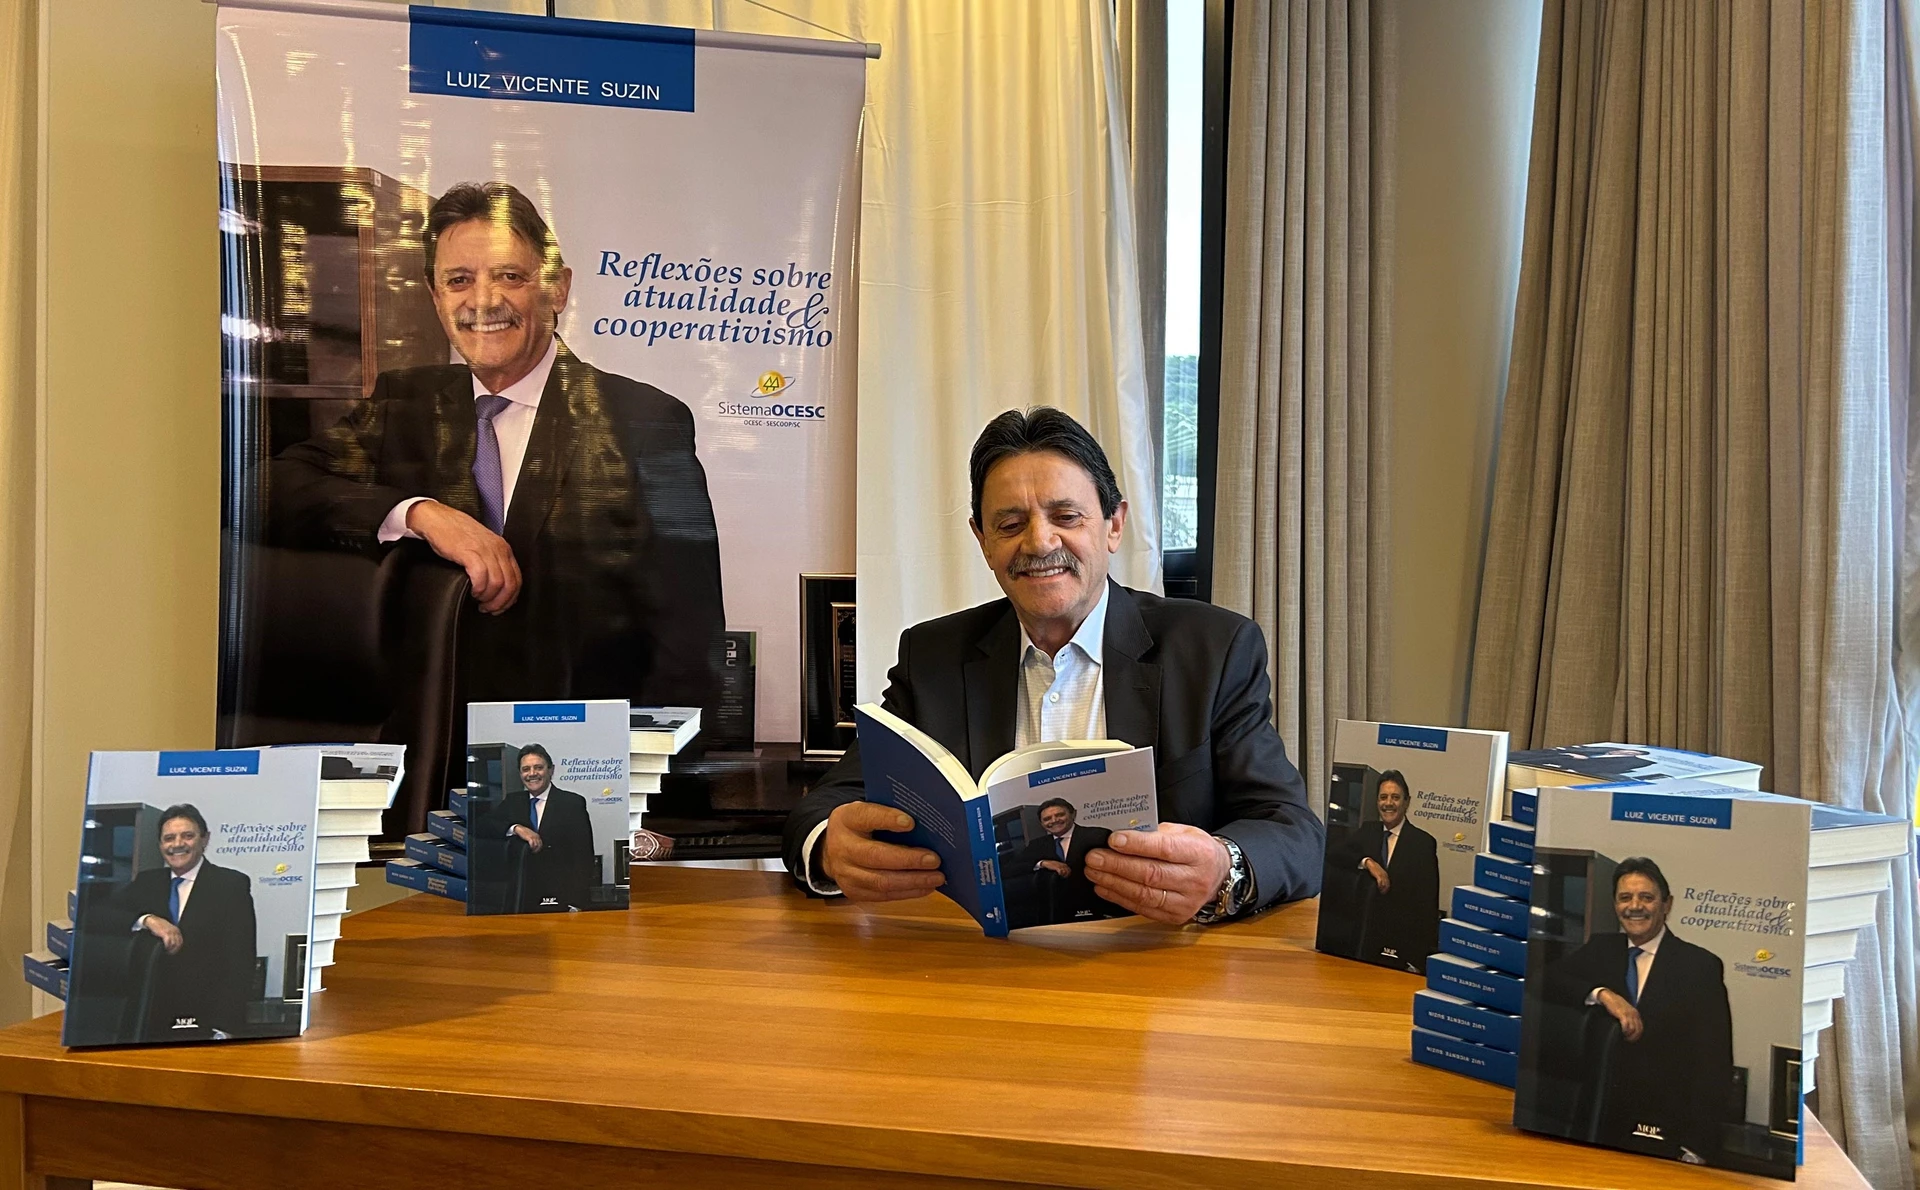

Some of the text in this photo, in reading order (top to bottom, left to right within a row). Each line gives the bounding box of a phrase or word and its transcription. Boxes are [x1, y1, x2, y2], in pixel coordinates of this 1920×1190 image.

[446, 71, 660, 100] LUIZ VICENTE SUZIN
[596, 250, 832, 290] Reflexões sobre
[623, 285, 830, 329] atualidade &
[593, 316, 833, 348] cooperativismo
[1399, 739, 1421, 747] VICENTE
[561, 757, 623, 767] Reflexões sobre
[189, 766, 222, 774] VICENTE
[567, 765, 611, 773] atualidade
[560, 773, 623, 783] cooperativismo
[1052, 772, 1077, 781] VICENTE
[1083, 798, 1124, 810] Reflexões
[1416, 790, 1480, 807] Reflexões sobre
[1090, 801, 1137, 813] atualidade
[1422, 801, 1466, 814] atualidade
[1414, 809, 1477, 825] cooperativismo
[1624, 811, 1717, 825] LUIZ VICENTE SUZIN
[220, 822, 307, 835] Reflexões sobre
[227, 832, 290, 844] atualidade
[216, 843, 305, 856] cooperativismo
[1684, 887, 1795, 910] Reflexões sobre
[1694, 903, 1773, 921] atualidade
[1680, 916, 1794, 936] cooperativismo
[1441, 974, 1457, 982] SUZIN
[1459, 979, 1481, 989] VICENTE
[1428, 1011, 1486, 1031] LUIZ VICENTE SUZIN
[1426, 1046, 1485, 1066] LUIZ VICENTE SUZIN
